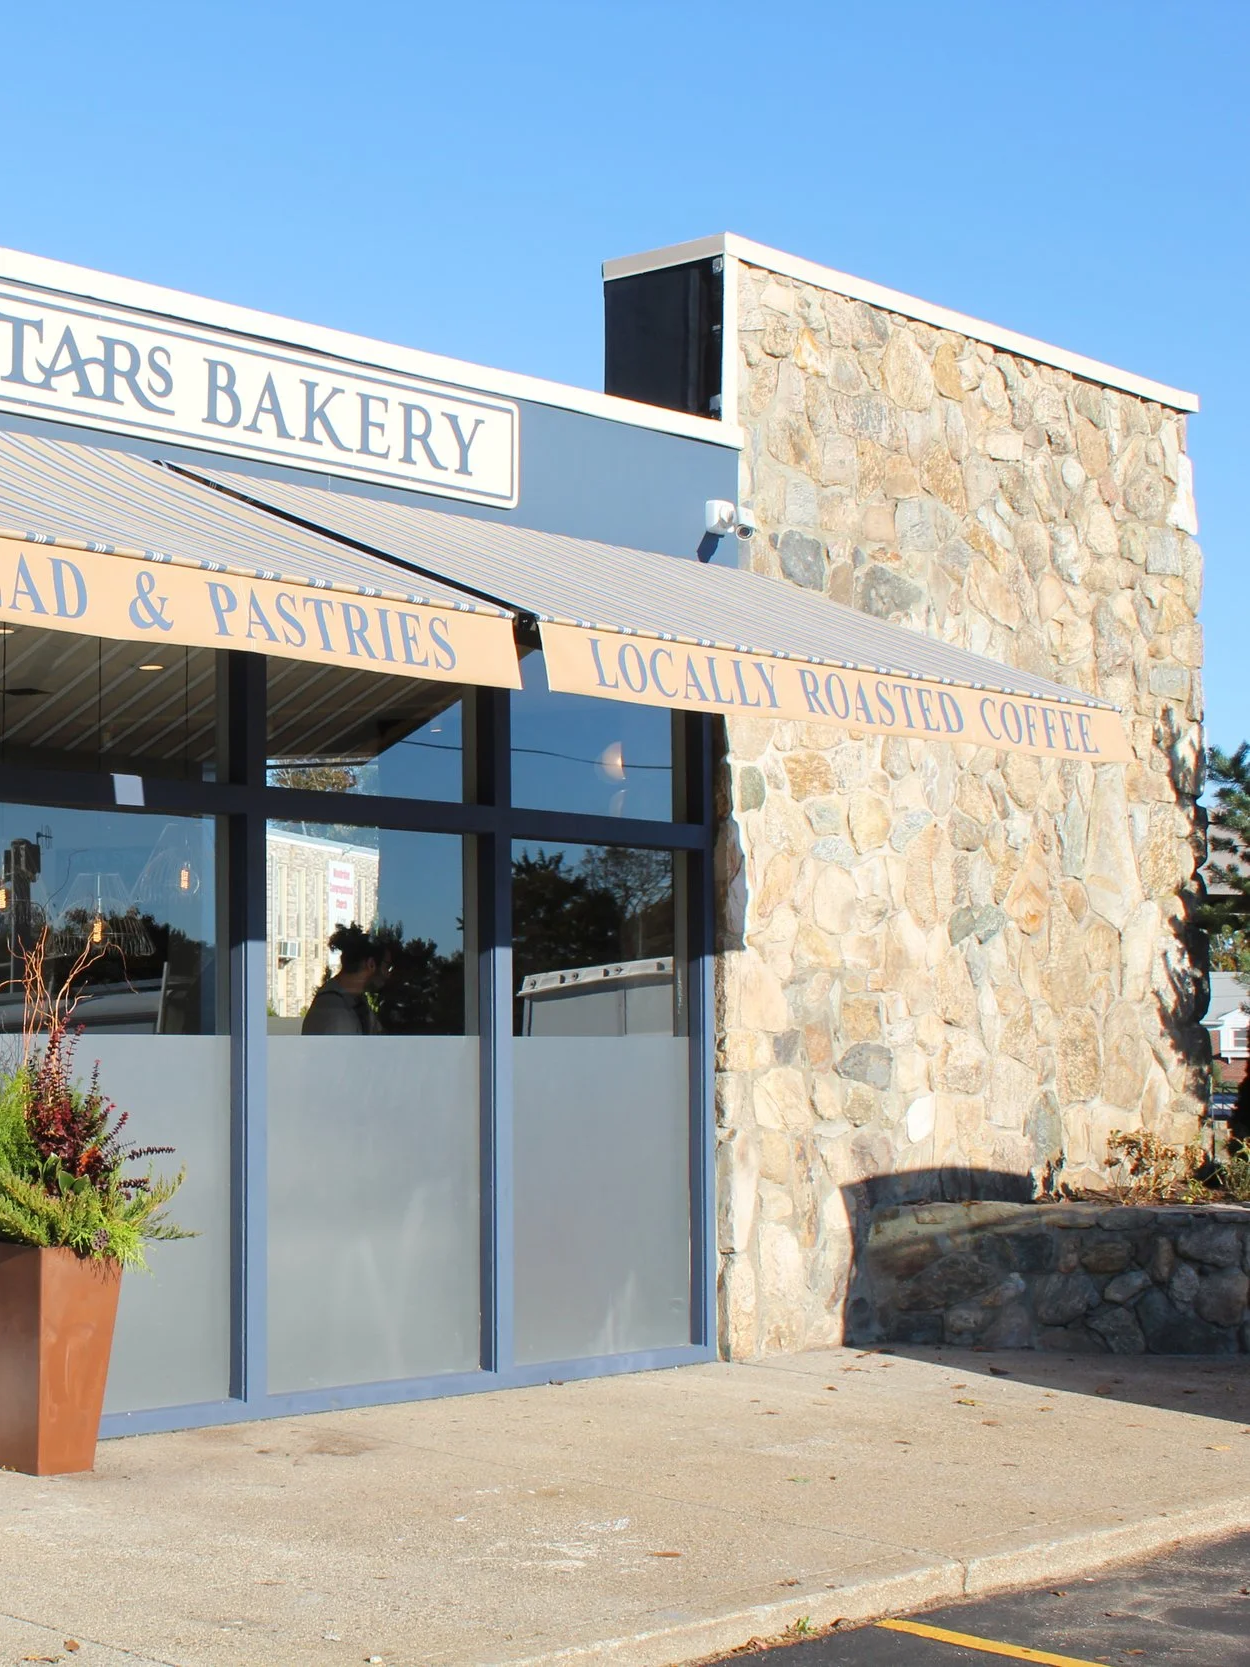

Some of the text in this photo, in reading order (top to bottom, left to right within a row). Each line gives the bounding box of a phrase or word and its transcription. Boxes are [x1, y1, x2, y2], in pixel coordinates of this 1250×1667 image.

[201, 357, 486, 477] BAKERY
[128, 570, 174, 631] &
[204, 581, 457, 672] PASTRIES
[589, 637, 1100, 754] LOCALLY ROASTED COFFEE
